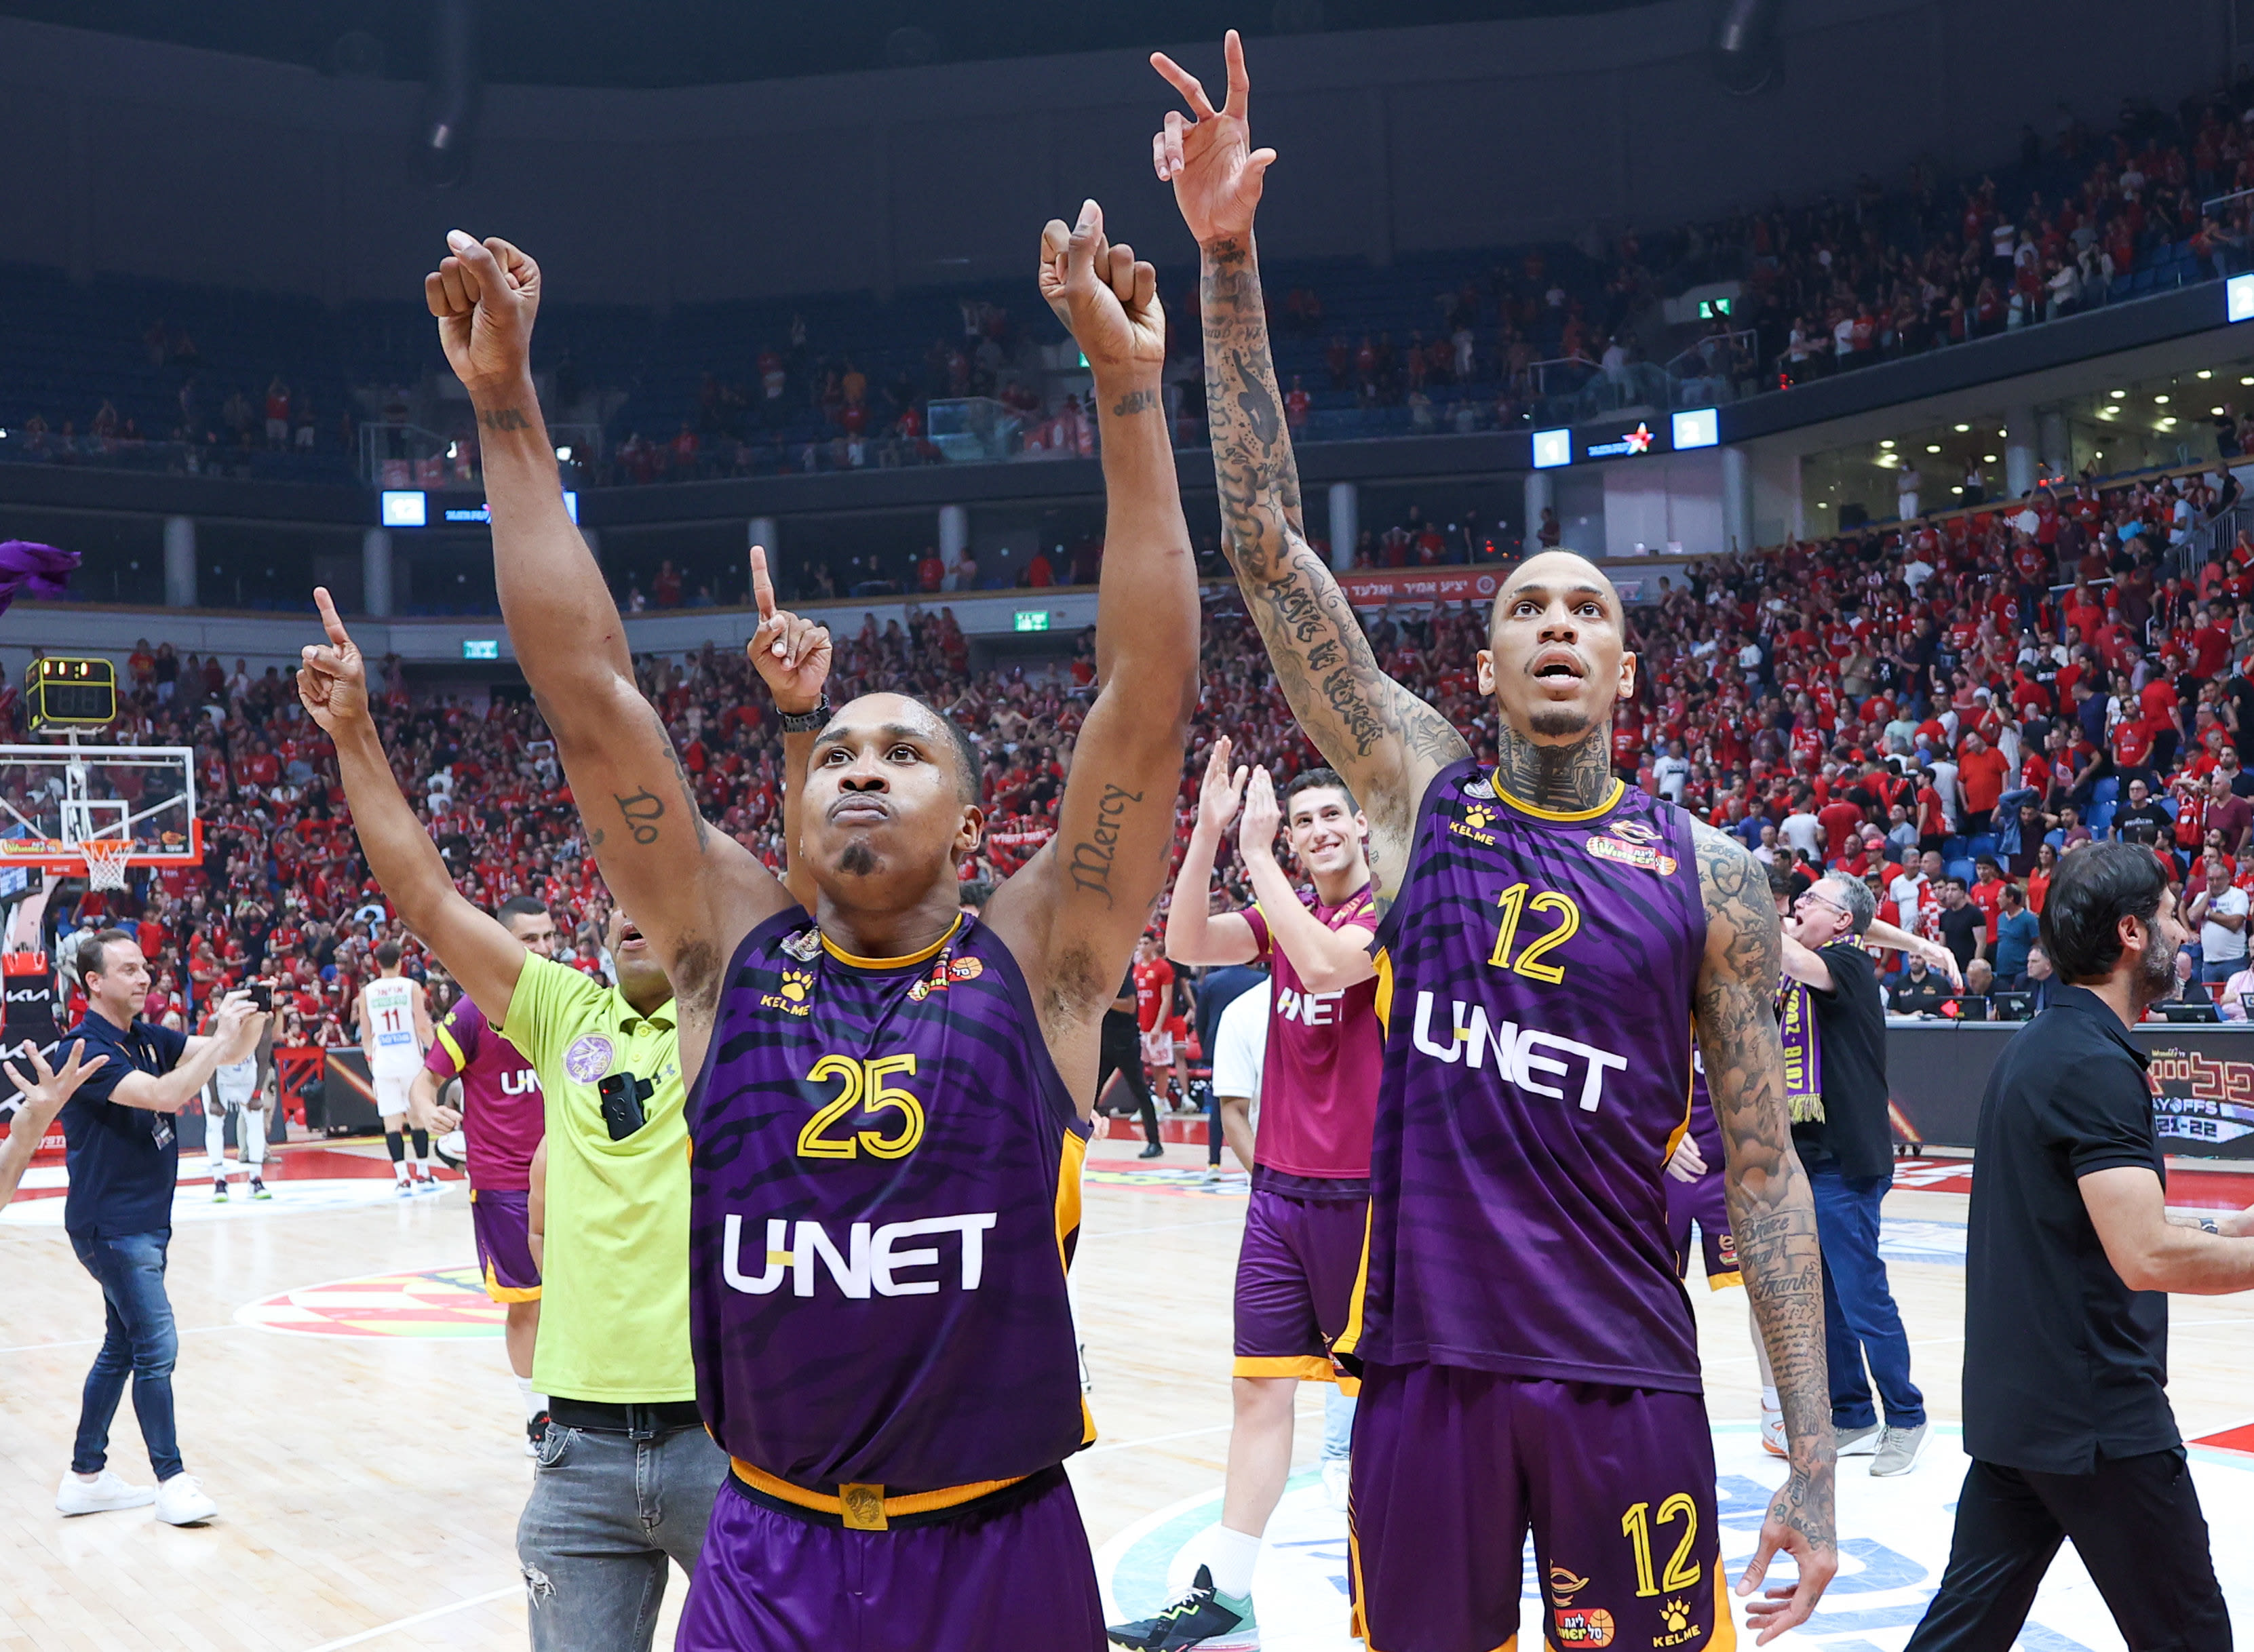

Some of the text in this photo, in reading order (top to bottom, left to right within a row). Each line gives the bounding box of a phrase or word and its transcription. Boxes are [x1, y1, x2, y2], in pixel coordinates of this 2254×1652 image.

[1070, 783, 1144, 902] Mercy
[1449, 821, 1496, 846] KELME
[1597, 841, 1655, 865] Winner
[1487, 882, 1580, 985] 12
[760, 994, 811, 1016] KELME
[381, 1007, 401, 1031] 11
[796, 1053, 926, 1160] 25
[1621, 1492, 1701, 1598] 12
[1564, 1613, 1585, 1628] ליגת
[1587, 1624, 1602, 1640] סל
[1652, 1624, 1701, 1648] KELME
